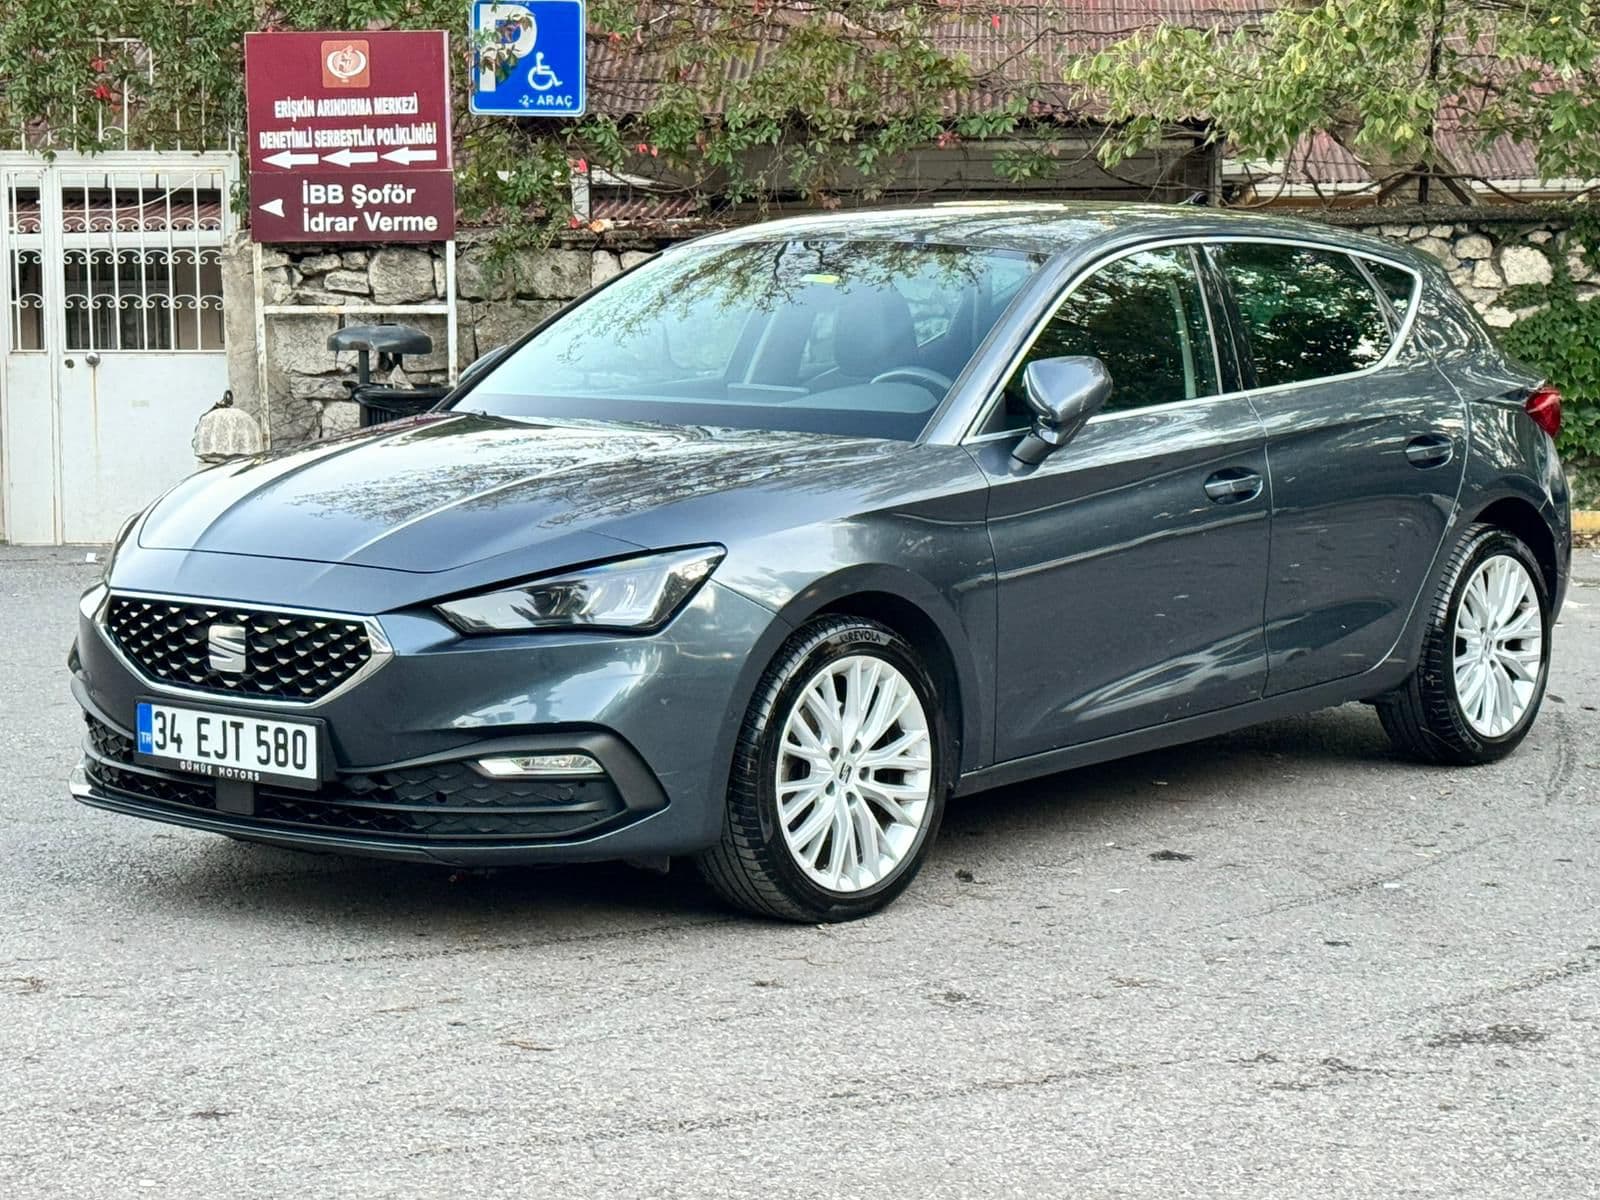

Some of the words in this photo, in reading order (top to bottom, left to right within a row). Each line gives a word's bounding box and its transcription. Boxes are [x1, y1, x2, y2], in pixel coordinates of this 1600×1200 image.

[479, 4, 537, 92] P
[274, 96, 315, 122] ERİŞKİN
[317, 97, 373, 117] ARINDIRMA
[374, 92, 418, 115] MERKEZİ
[536, 94, 573, 108] ARAÇ
[259, 126, 313, 149] DENETİMLİ
[314, 124, 376, 148] SERBESTLİK
[376, 122, 437, 146] POLİKLİNİĞİ
[302, 180, 344, 204] İBB
[351, 183, 417, 209] Şoför
[303, 207, 358, 232] İdrar
[363, 211, 438, 232] Verme
[154, 710, 183, 753] 34
[196, 717, 244, 762] EJT
[256, 724, 307, 770] 580
[218, 767, 260, 781] MOTORS
